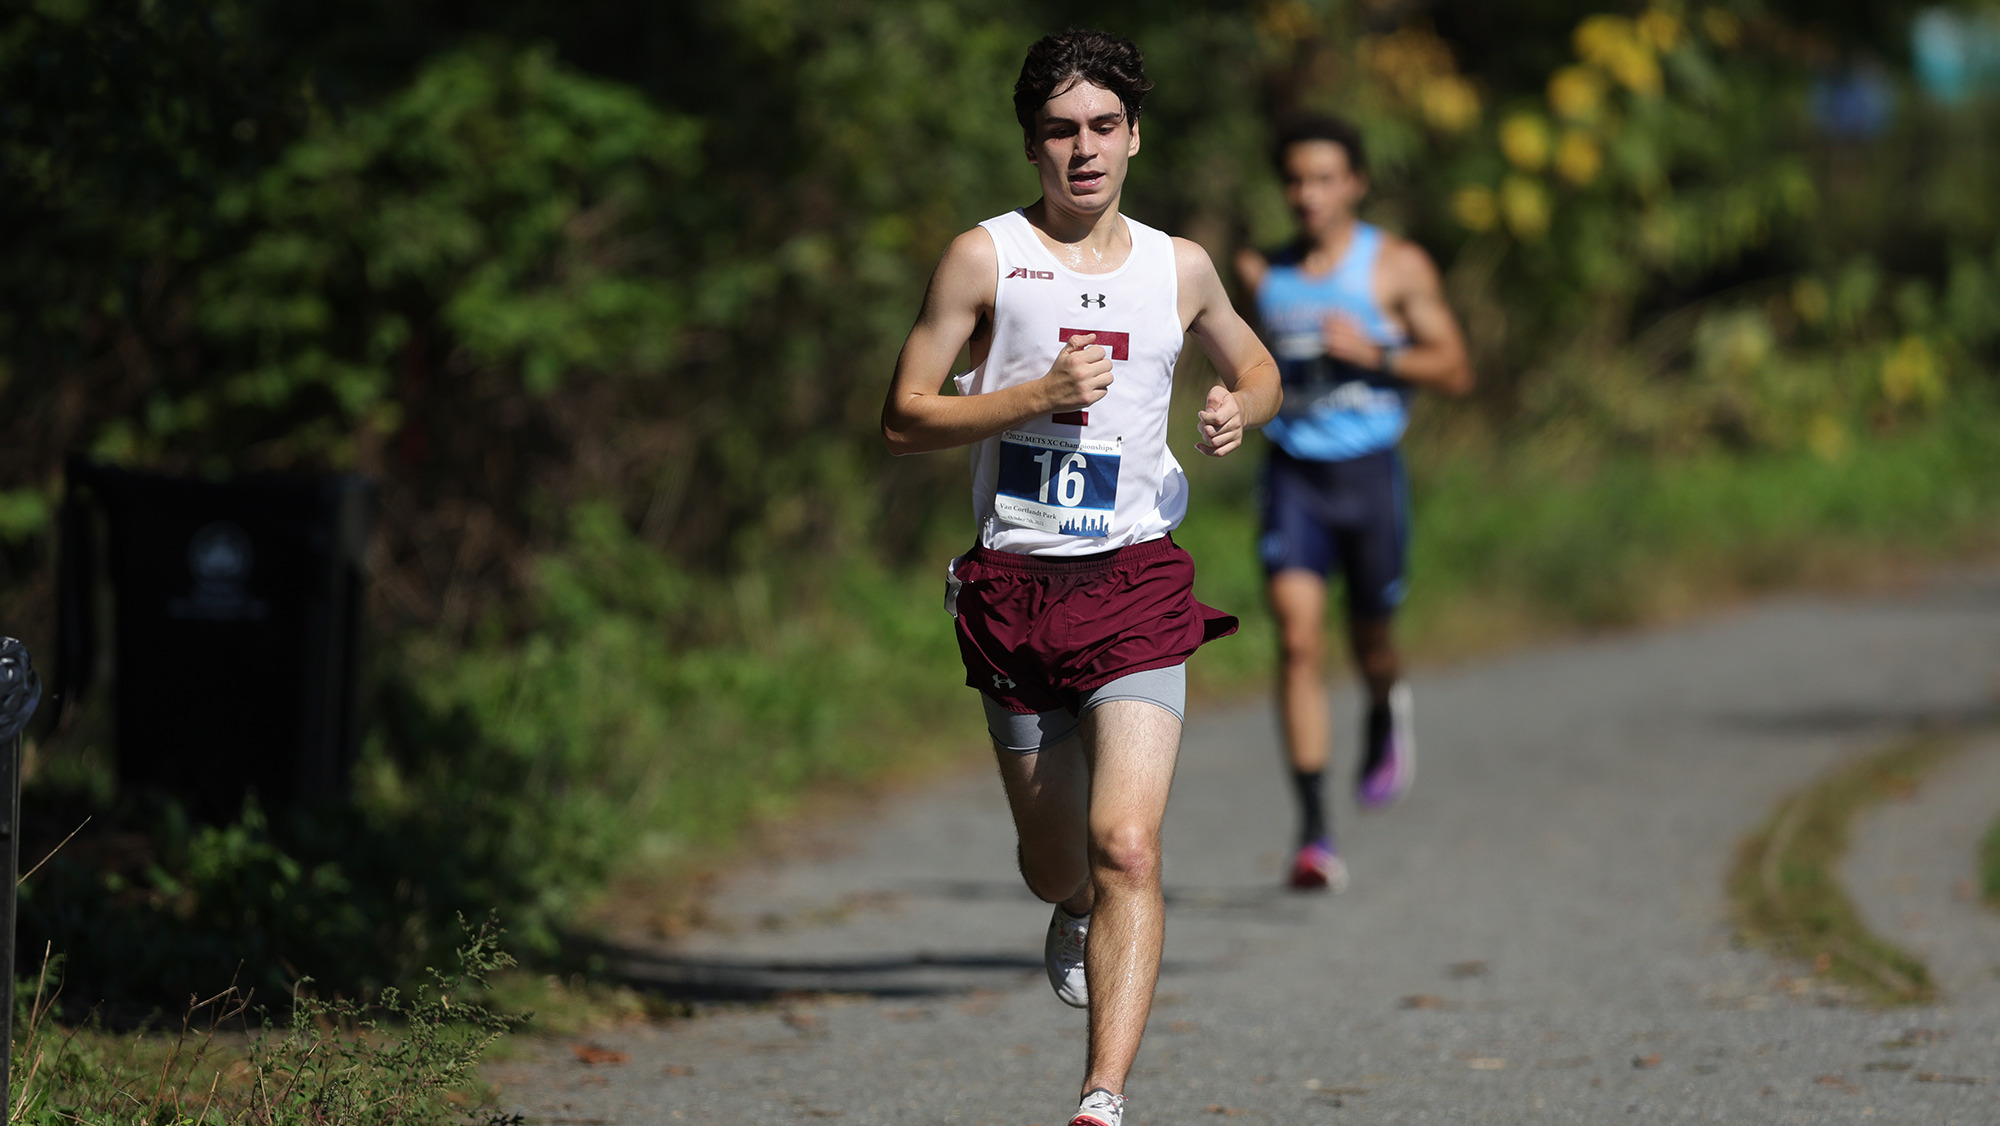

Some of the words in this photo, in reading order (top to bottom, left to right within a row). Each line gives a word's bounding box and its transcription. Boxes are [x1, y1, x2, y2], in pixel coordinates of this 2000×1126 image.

[1005, 267, 1054, 280] A10
[1008, 433, 1024, 441] 2022
[1025, 436, 1046, 445] METS
[1047, 439, 1058, 447] XC
[1059, 441, 1113, 452] Championships
[1033, 450, 1087, 507] 16
[1013, 505, 1042, 517] Cortlandt
[1042, 511, 1058, 520] Park
